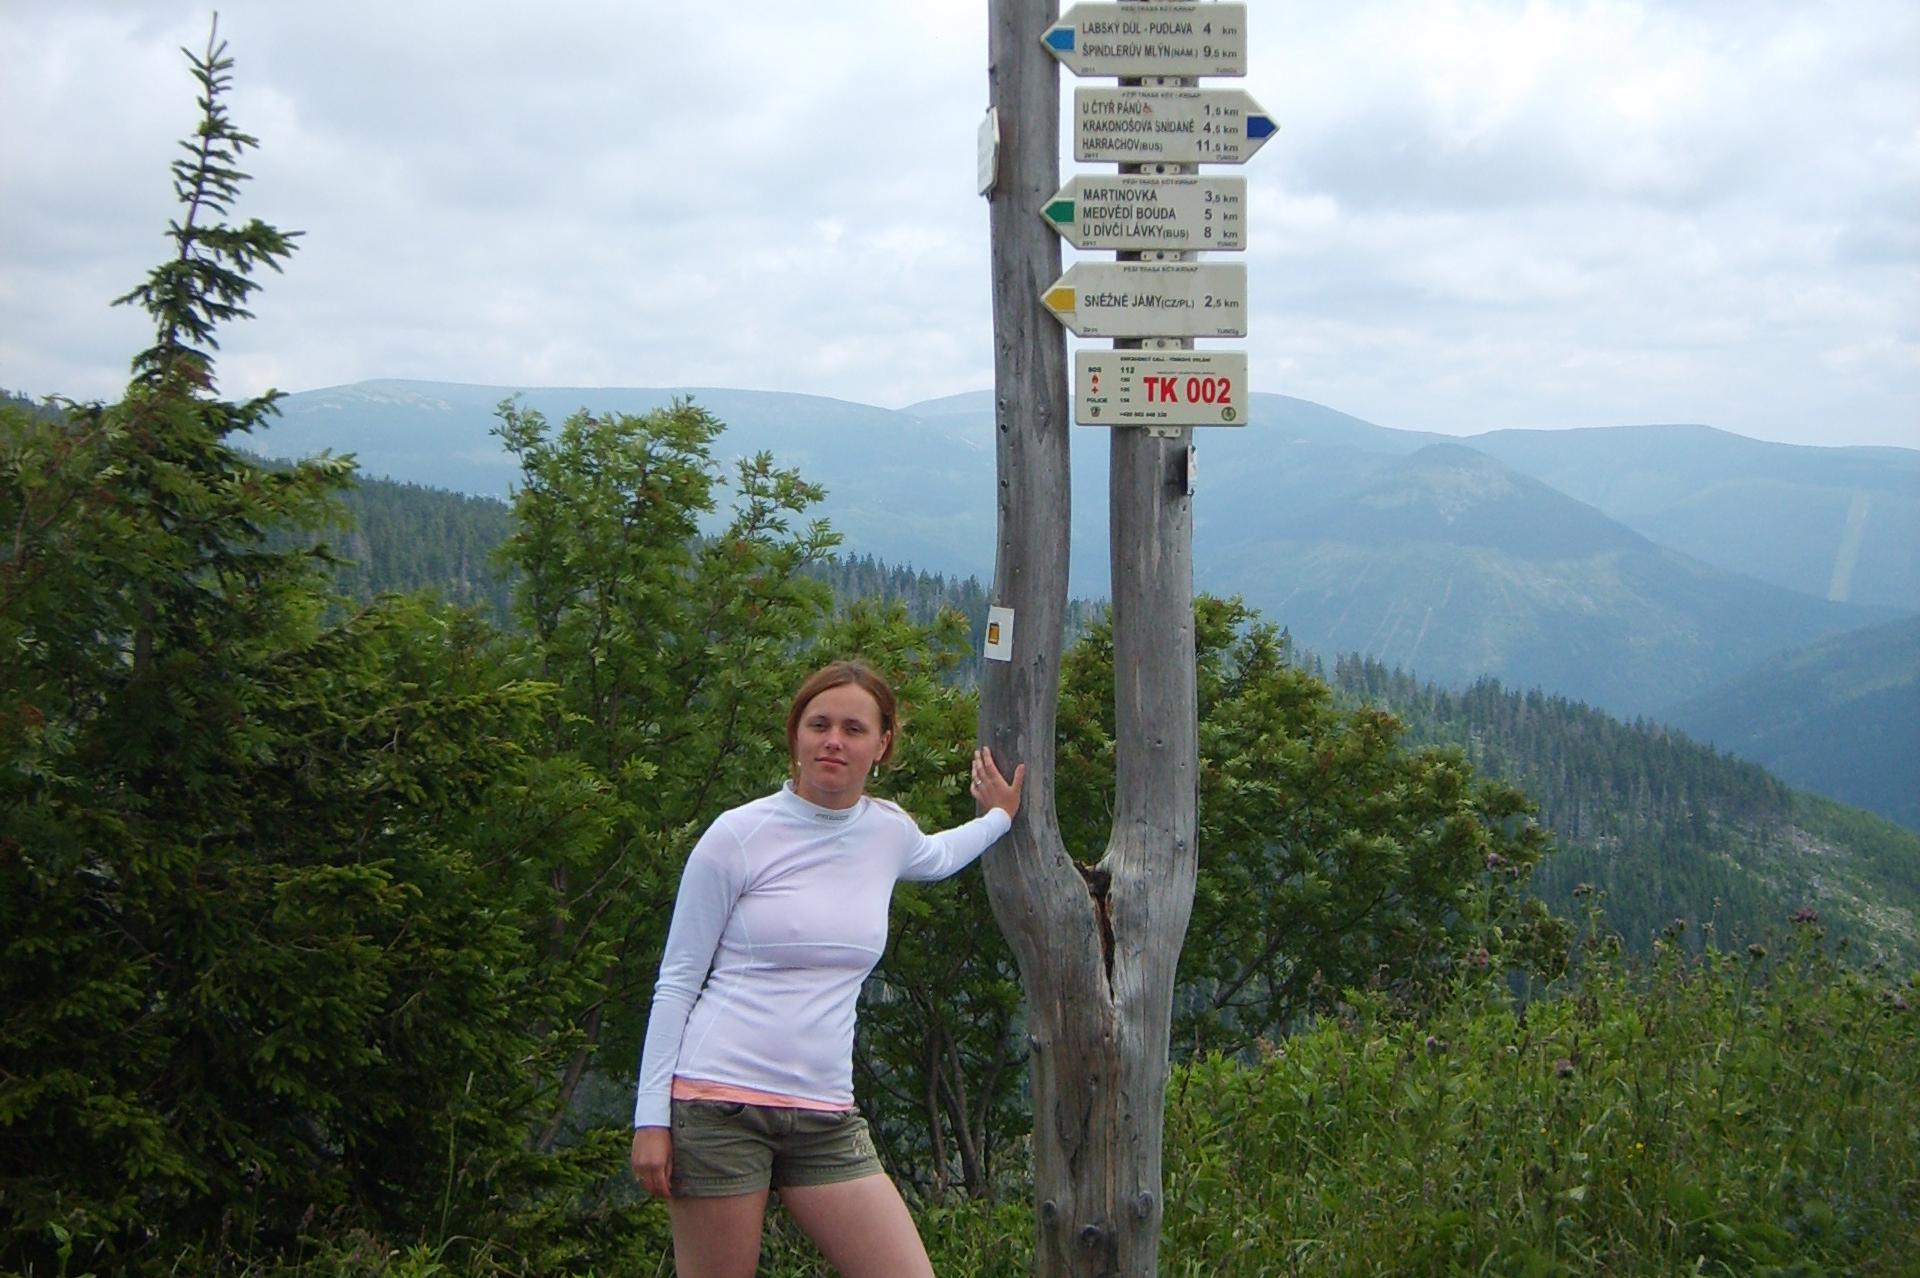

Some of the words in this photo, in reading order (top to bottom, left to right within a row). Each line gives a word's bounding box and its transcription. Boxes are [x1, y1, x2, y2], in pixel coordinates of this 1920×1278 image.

[1082, 20, 1120, 34] LABSKÝ
[1122, 19, 1141, 34] DŮL
[1149, 22, 1193, 34] PUDLAVA
[1203, 22, 1211, 34] 4
[1222, 26, 1238, 35] km
[1082, 41, 1142, 57] ŠPINDLERŮV
[1222, 48, 1238, 57] km
[1082, 102, 1089, 114] U
[1091, 99, 1114, 114] ČTYŘ
[1117, 99, 1142, 114] PÁNŮ
[1223, 107, 1239, 116] km
[1082, 117, 1153, 132] KRAKONOŠOVA
[1223, 125, 1239, 134] km
[1223, 143, 1239, 152] km
[1083, 189, 1158, 201] MARTINOVKA
[1223, 195, 1238, 203] km
[1082, 204, 1133, 219] MEDVĚDÍ
[1136, 207, 1176, 220] BOUDA
[1204, 208, 1212, 220] 5
[1223, 212, 1238, 221] km
[1083, 224, 1091, 237] U
[1094, 222, 1123, 237] DÍVČÍ
[1204, 226, 1212, 238] 8
[1223, 230, 1238, 238] km
[1084, 292, 1129, 307] SNĚŽNÉ
[1224, 299, 1239, 308] km
[1120, 366, 1135, 374] 112
[1143, 376, 1178, 403] TK
[1186, 375, 1232, 404] 002
